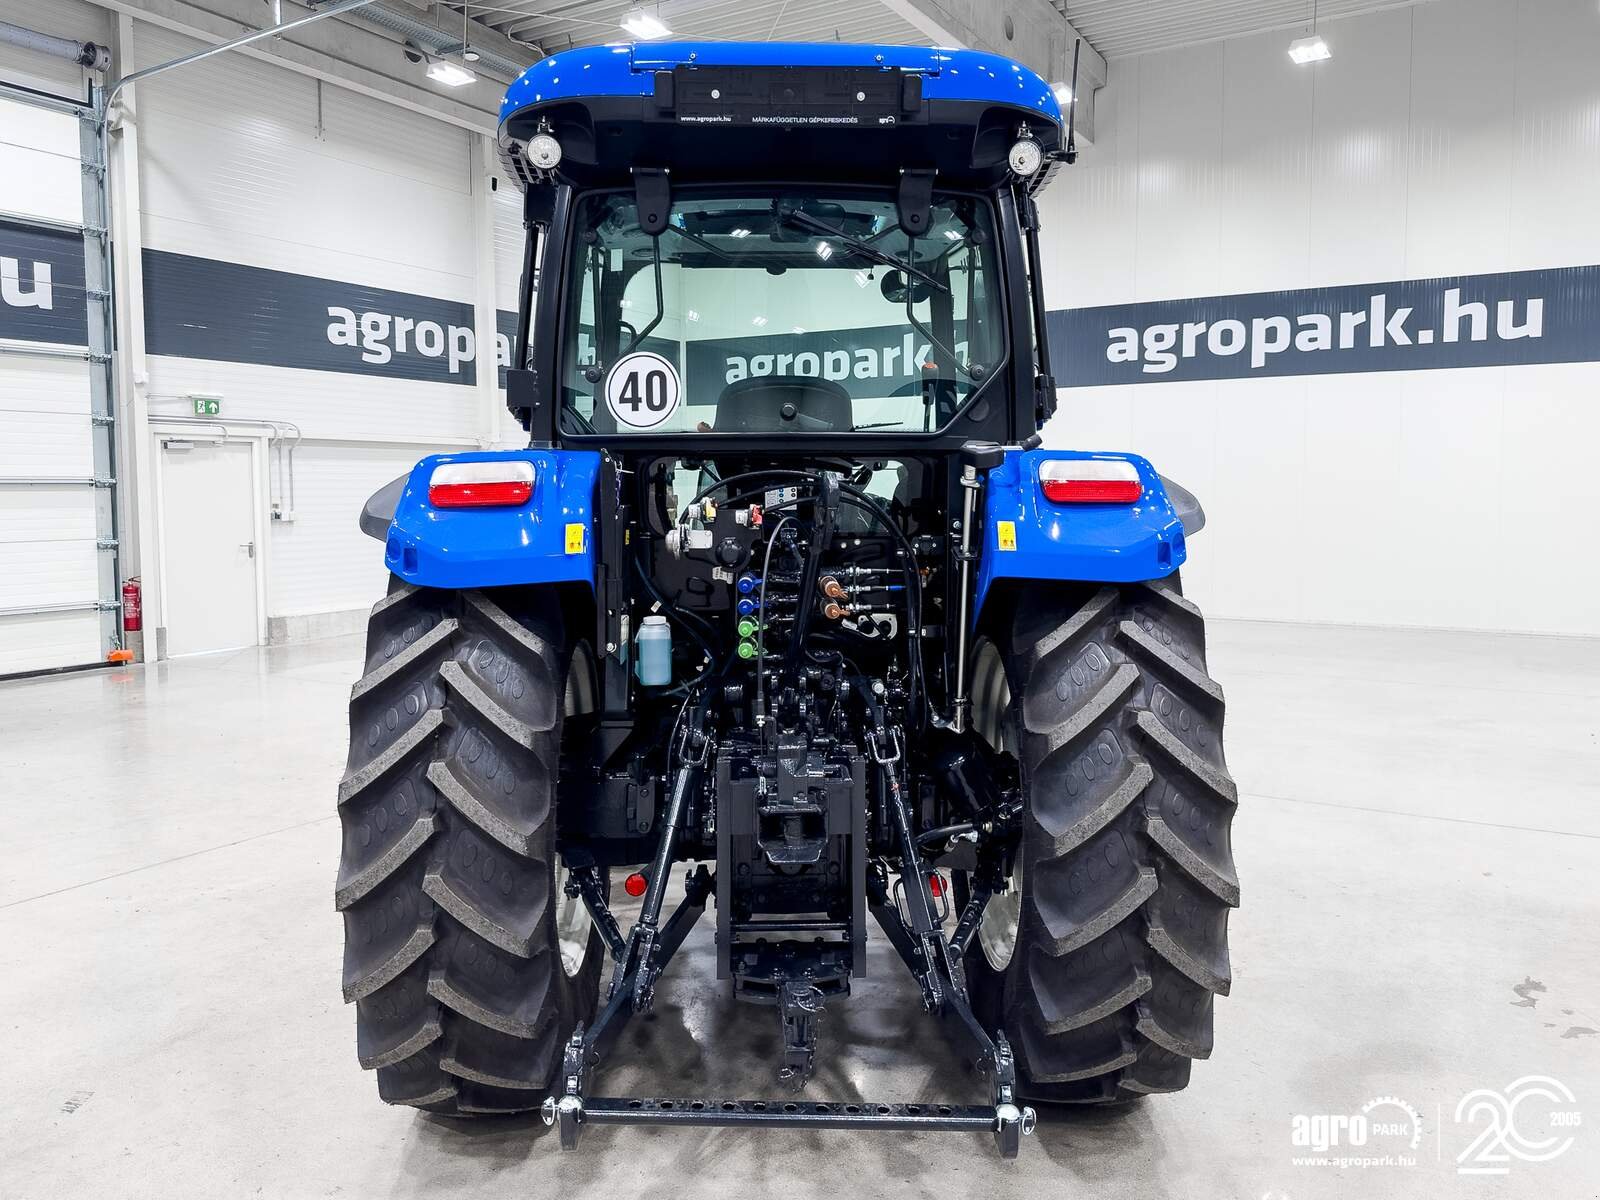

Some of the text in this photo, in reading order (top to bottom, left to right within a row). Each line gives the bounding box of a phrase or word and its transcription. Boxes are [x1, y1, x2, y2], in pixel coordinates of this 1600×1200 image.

[680, 115, 732, 123] www.agropark.hu
[1106, 287, 1544, 375] agropark.hu
[618, 369, 668, 412] 40
